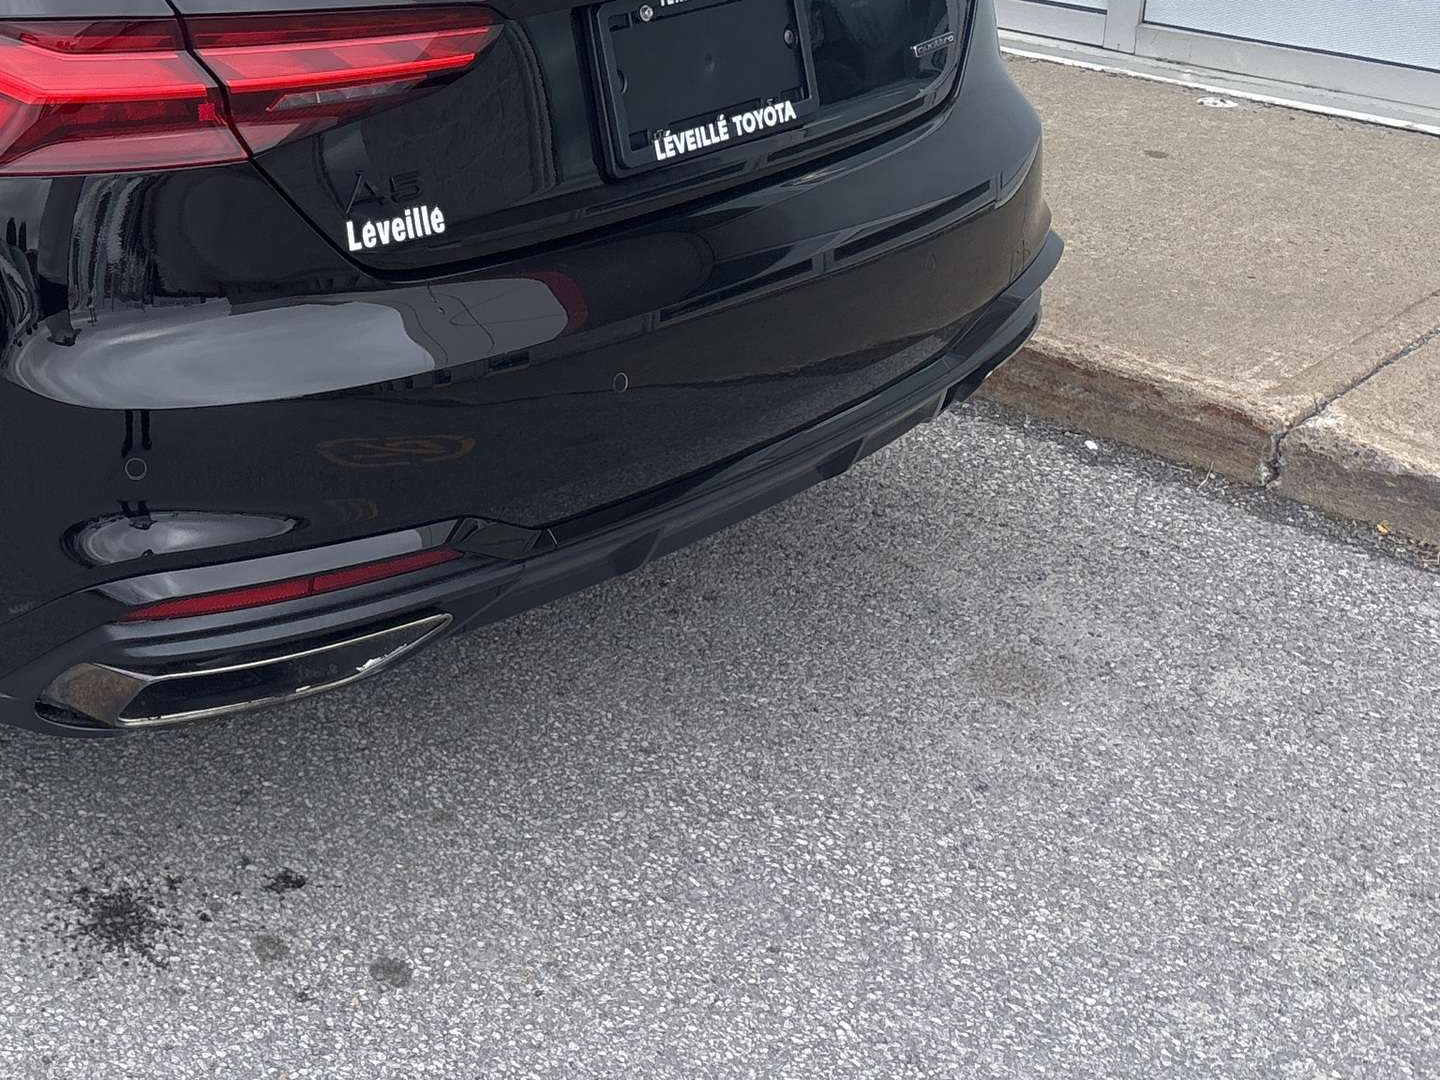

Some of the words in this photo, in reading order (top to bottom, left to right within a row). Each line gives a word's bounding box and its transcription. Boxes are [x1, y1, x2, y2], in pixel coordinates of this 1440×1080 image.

[653, 113, 730, 161] LÉVEILLÉ
[731, 100, 797, 136] TOYOTA
[345, 169, 424, 216] A5
[345, 204, 446, 252] Léveillé
